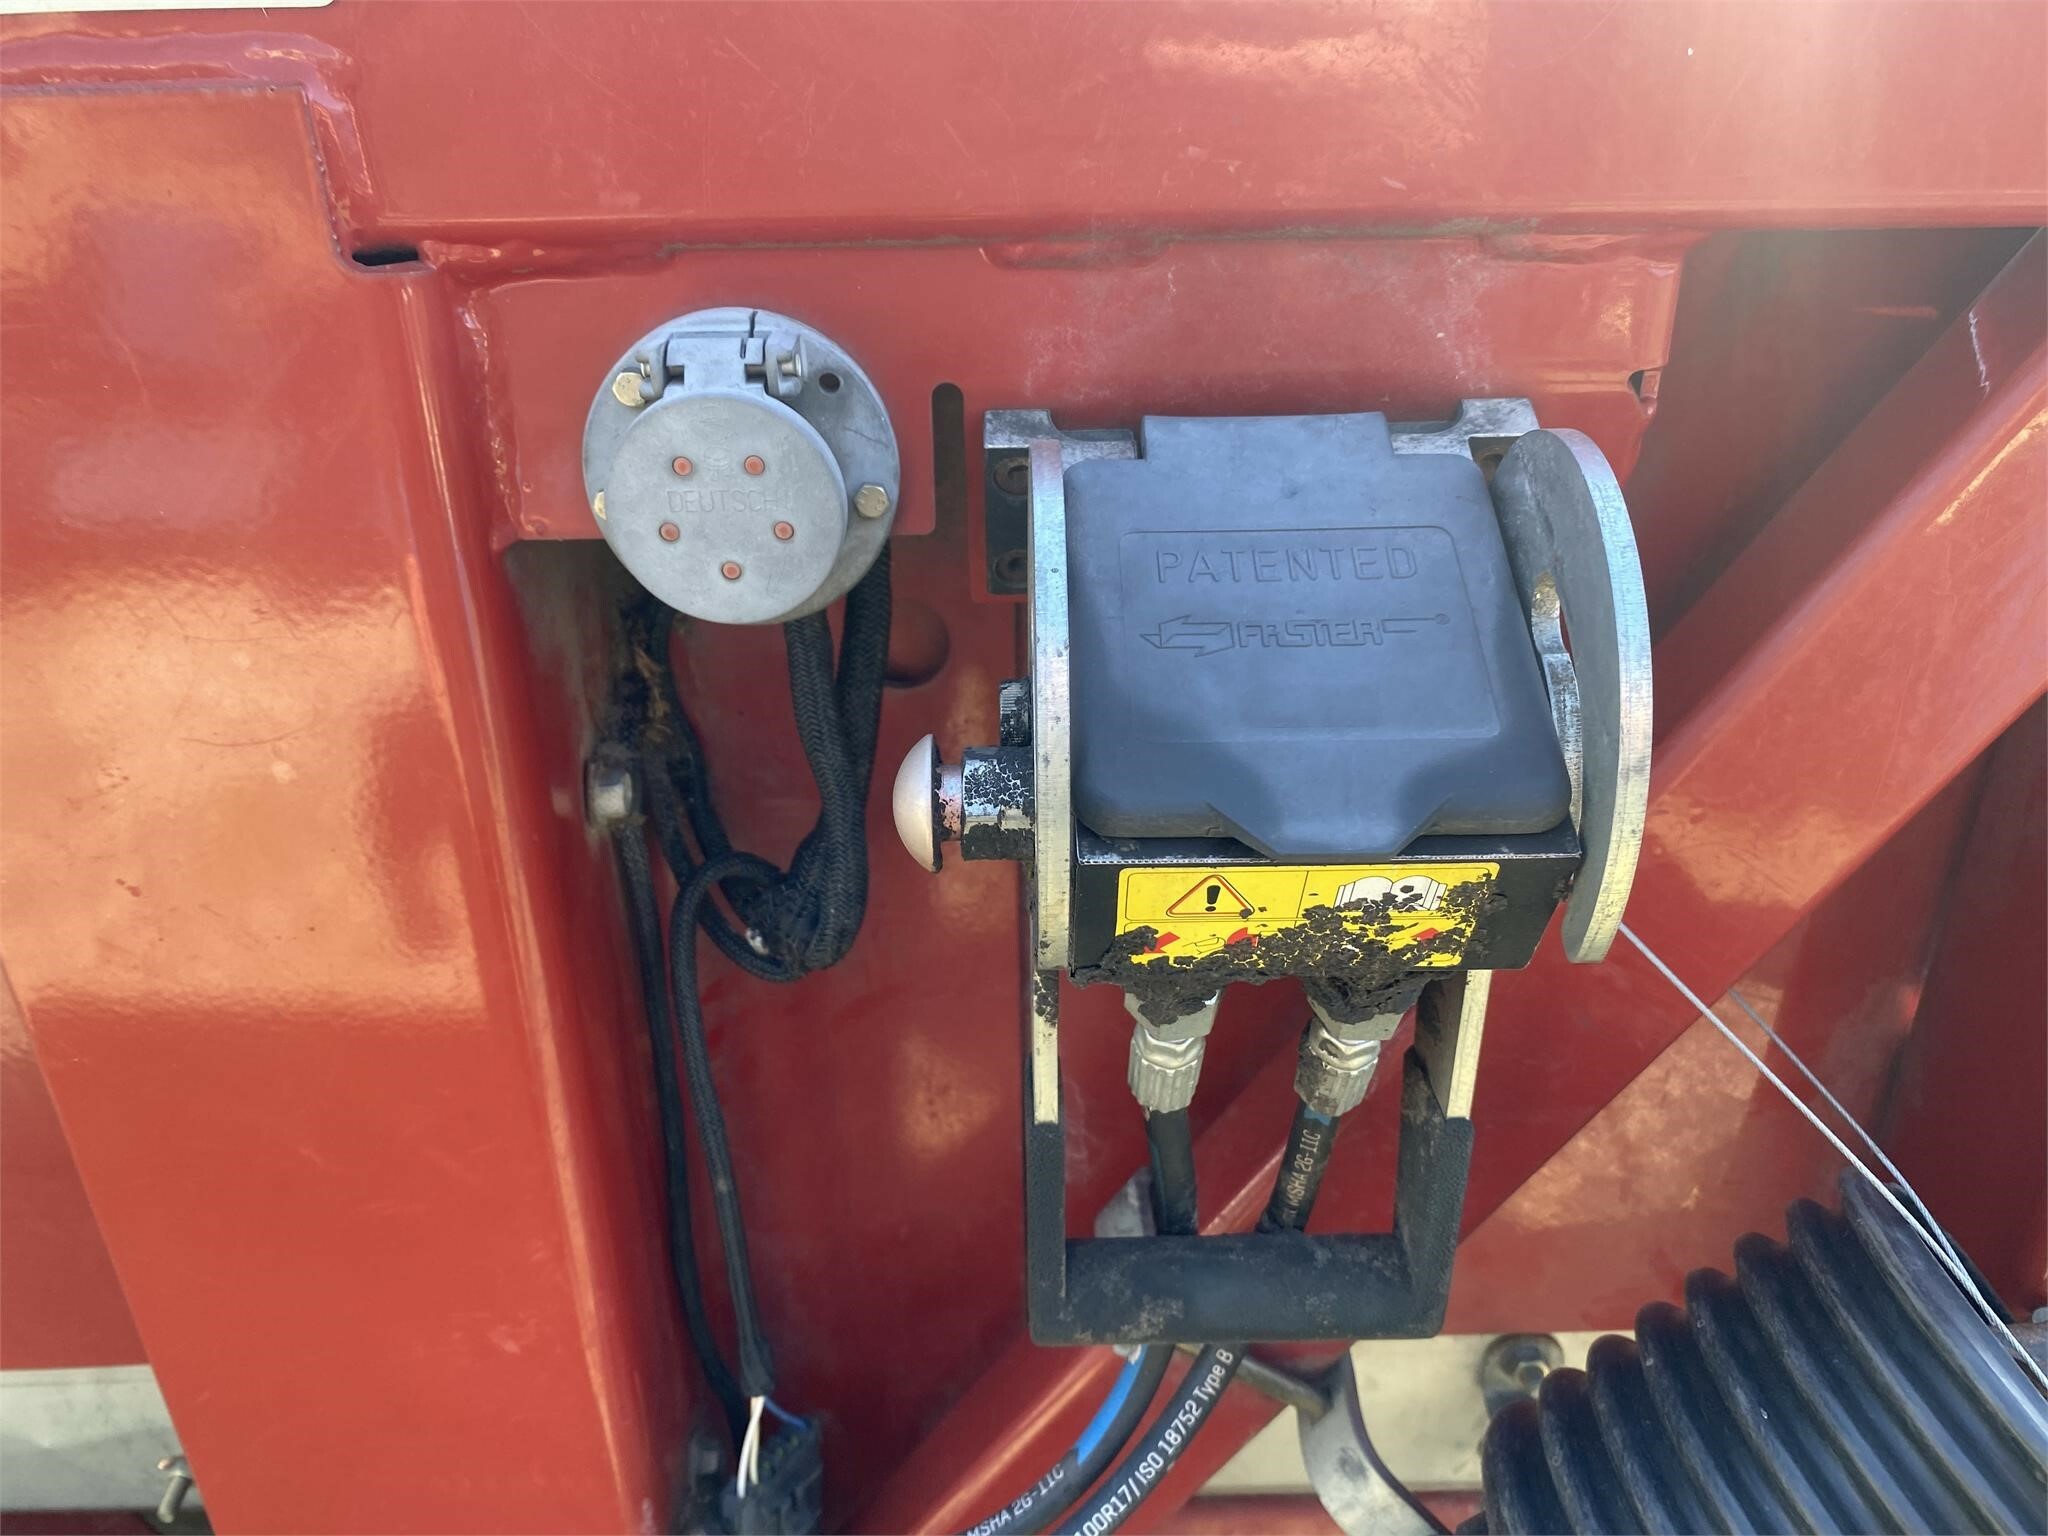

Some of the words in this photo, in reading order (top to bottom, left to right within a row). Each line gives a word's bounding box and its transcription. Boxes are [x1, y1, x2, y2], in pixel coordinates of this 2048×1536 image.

[666, 489, 779, 513] DEUTSCH
[1156, 546, 1419, 584] PATENTED
[1236, 618, 1384, 649] FASTER
[1286, 1172, 1307, 1207] MSHA
[1158, 1399, 1203, 1456] 18752
[1193, 1363, 1227, 1402] Type
[1215, 1347, 1234, 1365] B
